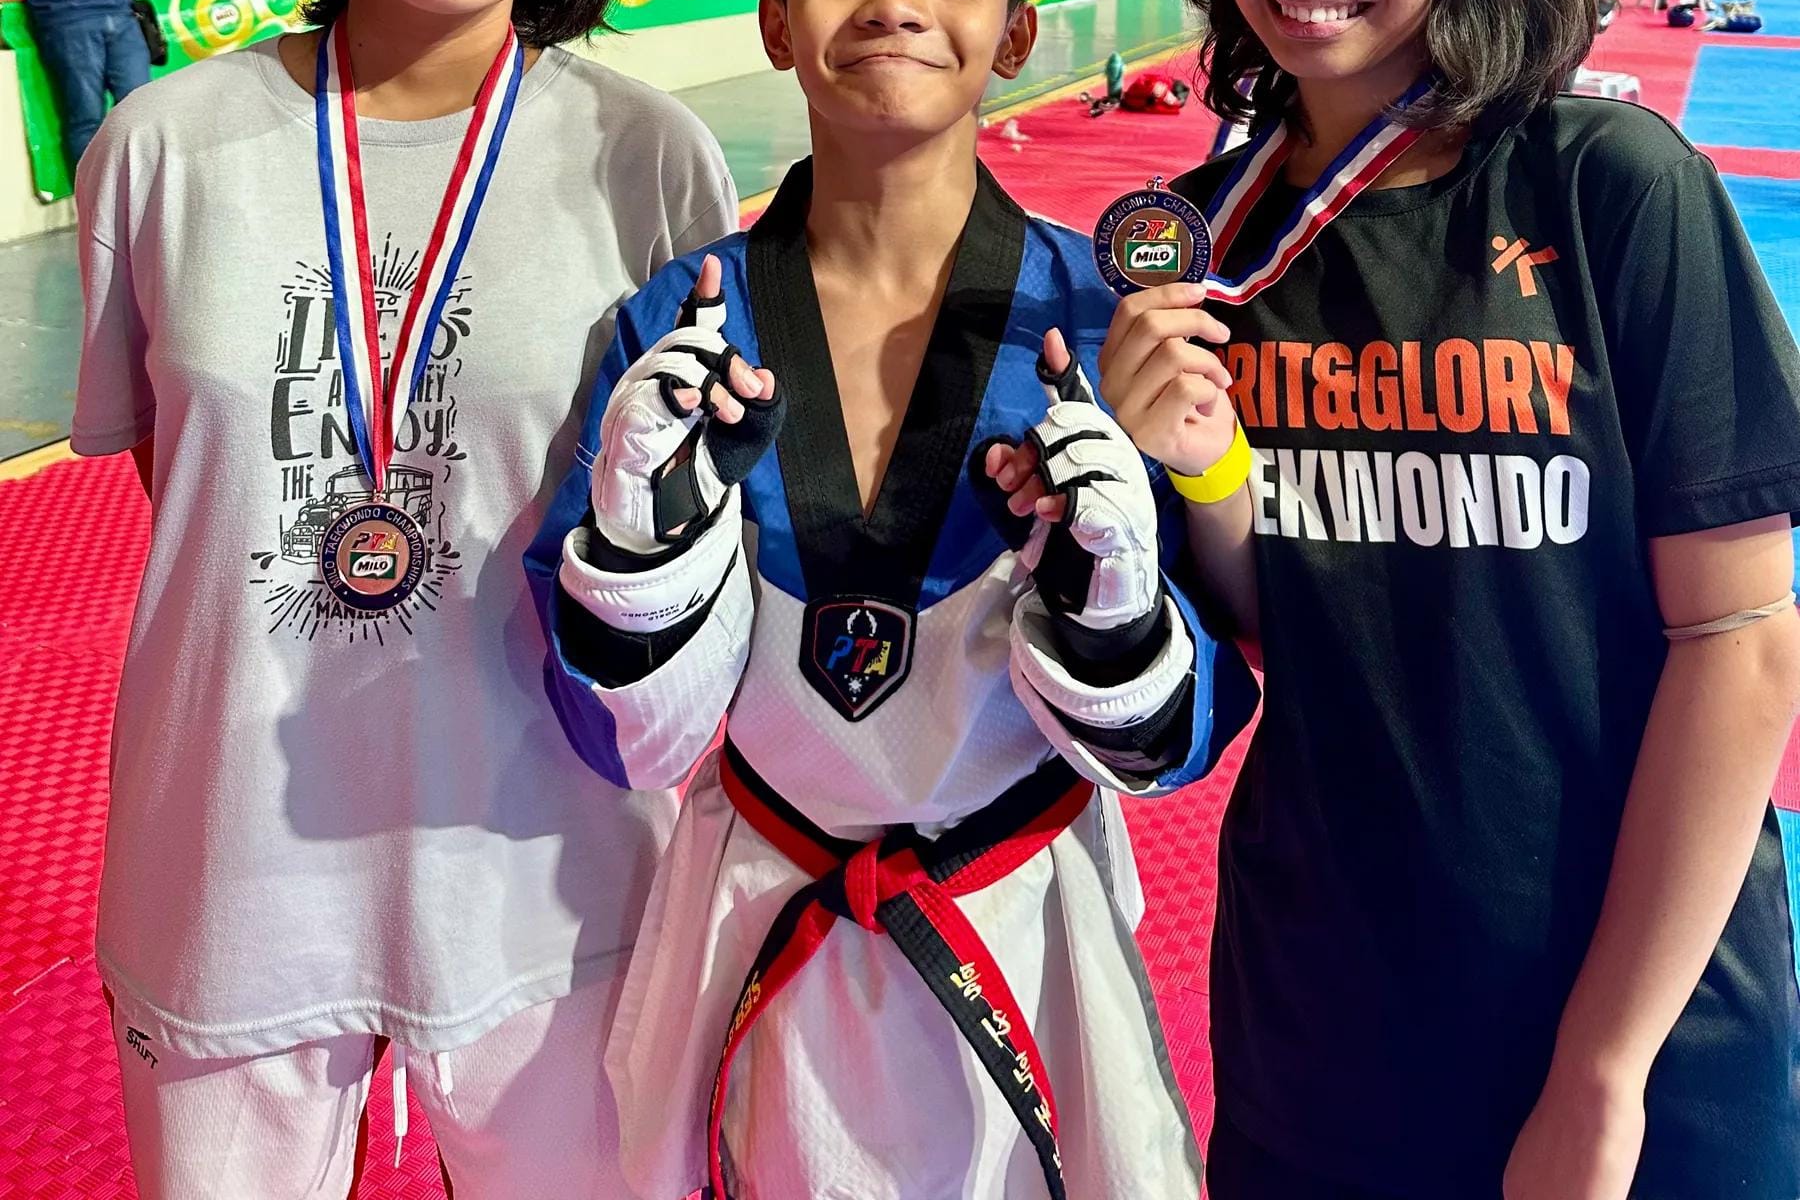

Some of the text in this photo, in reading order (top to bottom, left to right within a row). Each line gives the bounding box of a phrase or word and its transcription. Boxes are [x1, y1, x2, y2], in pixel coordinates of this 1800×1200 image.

[1098, 194, 1208, 282] MILO TAEKWONDO CHAMPIONSHIPS
[1135, 251, 1170, 263] MILO
[1217, 337, 1575, 436] RIT&GLORY
[271, 377, 444, 461] ENOY
[281, 464, 314, 501] THE
[1251, 448, 1590, 550] EKWONDO
[324, 507, 381, 555] TAEKWONDO
[386, 510, 422, 591] CHAMPIONSHIPS
[324, 561, 342, 589] MILO
[357, 560, 389, 572] MILO
[126, 1029, 159, 1070] SHIFT
